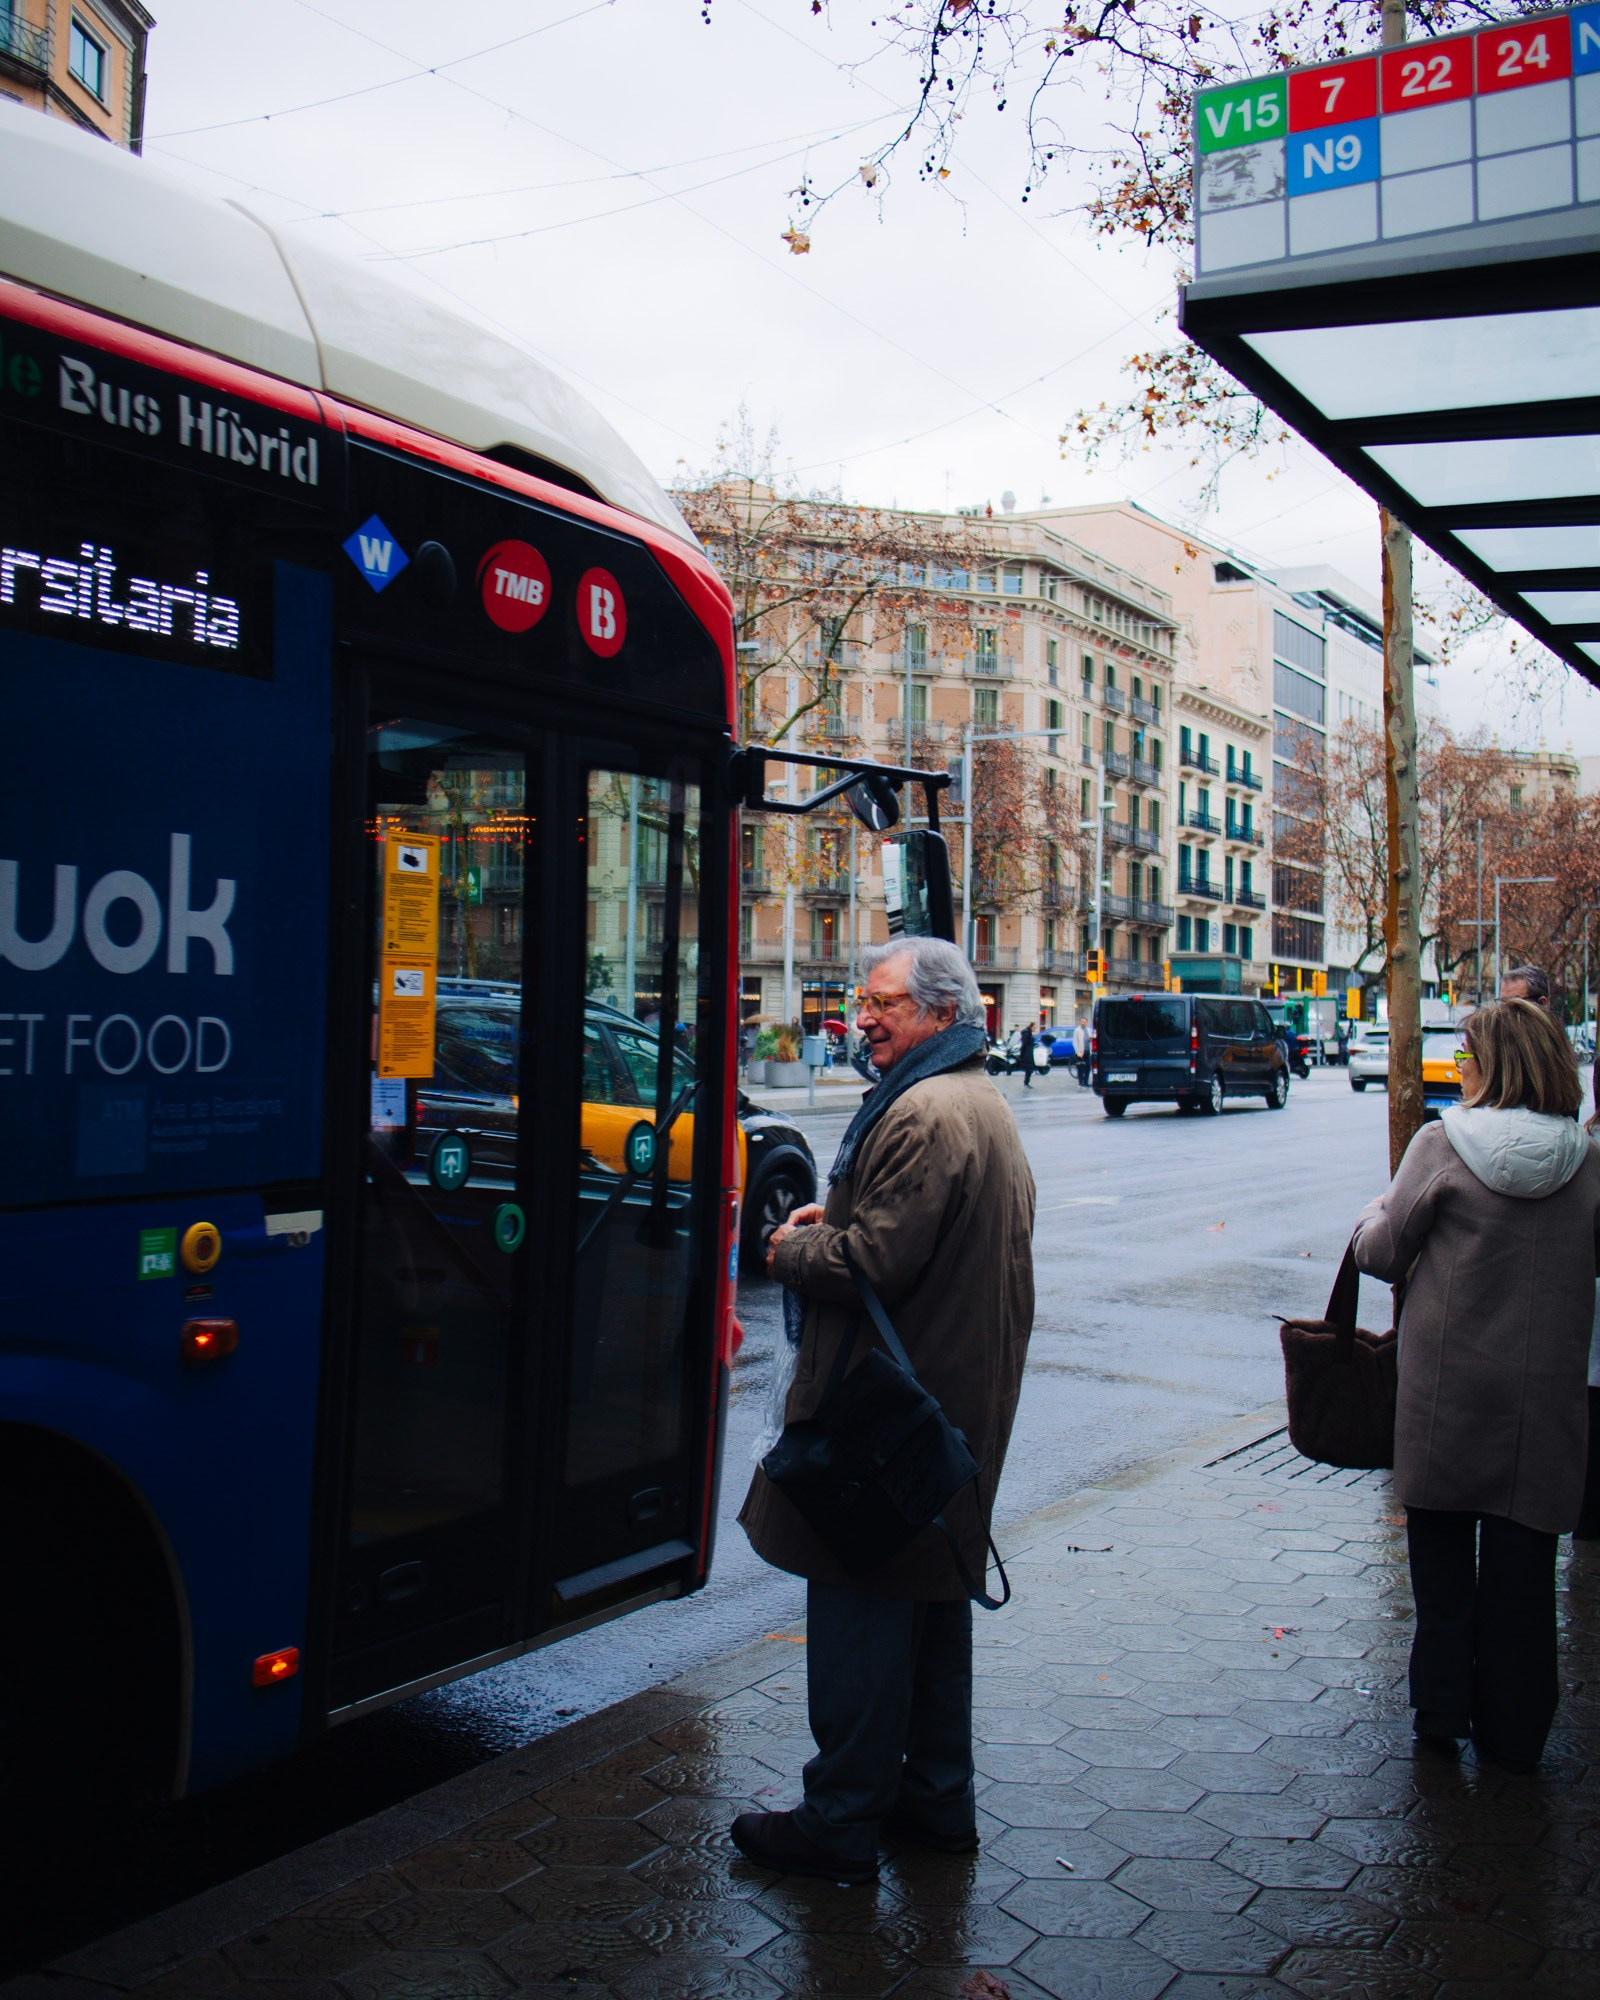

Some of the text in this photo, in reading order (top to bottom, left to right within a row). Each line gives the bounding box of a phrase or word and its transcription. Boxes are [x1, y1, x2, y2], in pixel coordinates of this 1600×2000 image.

[1205, 93, 1280, 139] V15
[1319, 77, 1346, 113] 7
[1401, 56, 1452, 98] 22
[1497, 33, 1550, 77] 24
[1303, 134, 1362, 179] N9
[59, 355, 162, 436] Bus
[358, 534, 392, 573] W
[494, 568, 544, 606] TMB
[590, 585, 616, 639] B
[65, 1013, 231, 1075] FOOD
